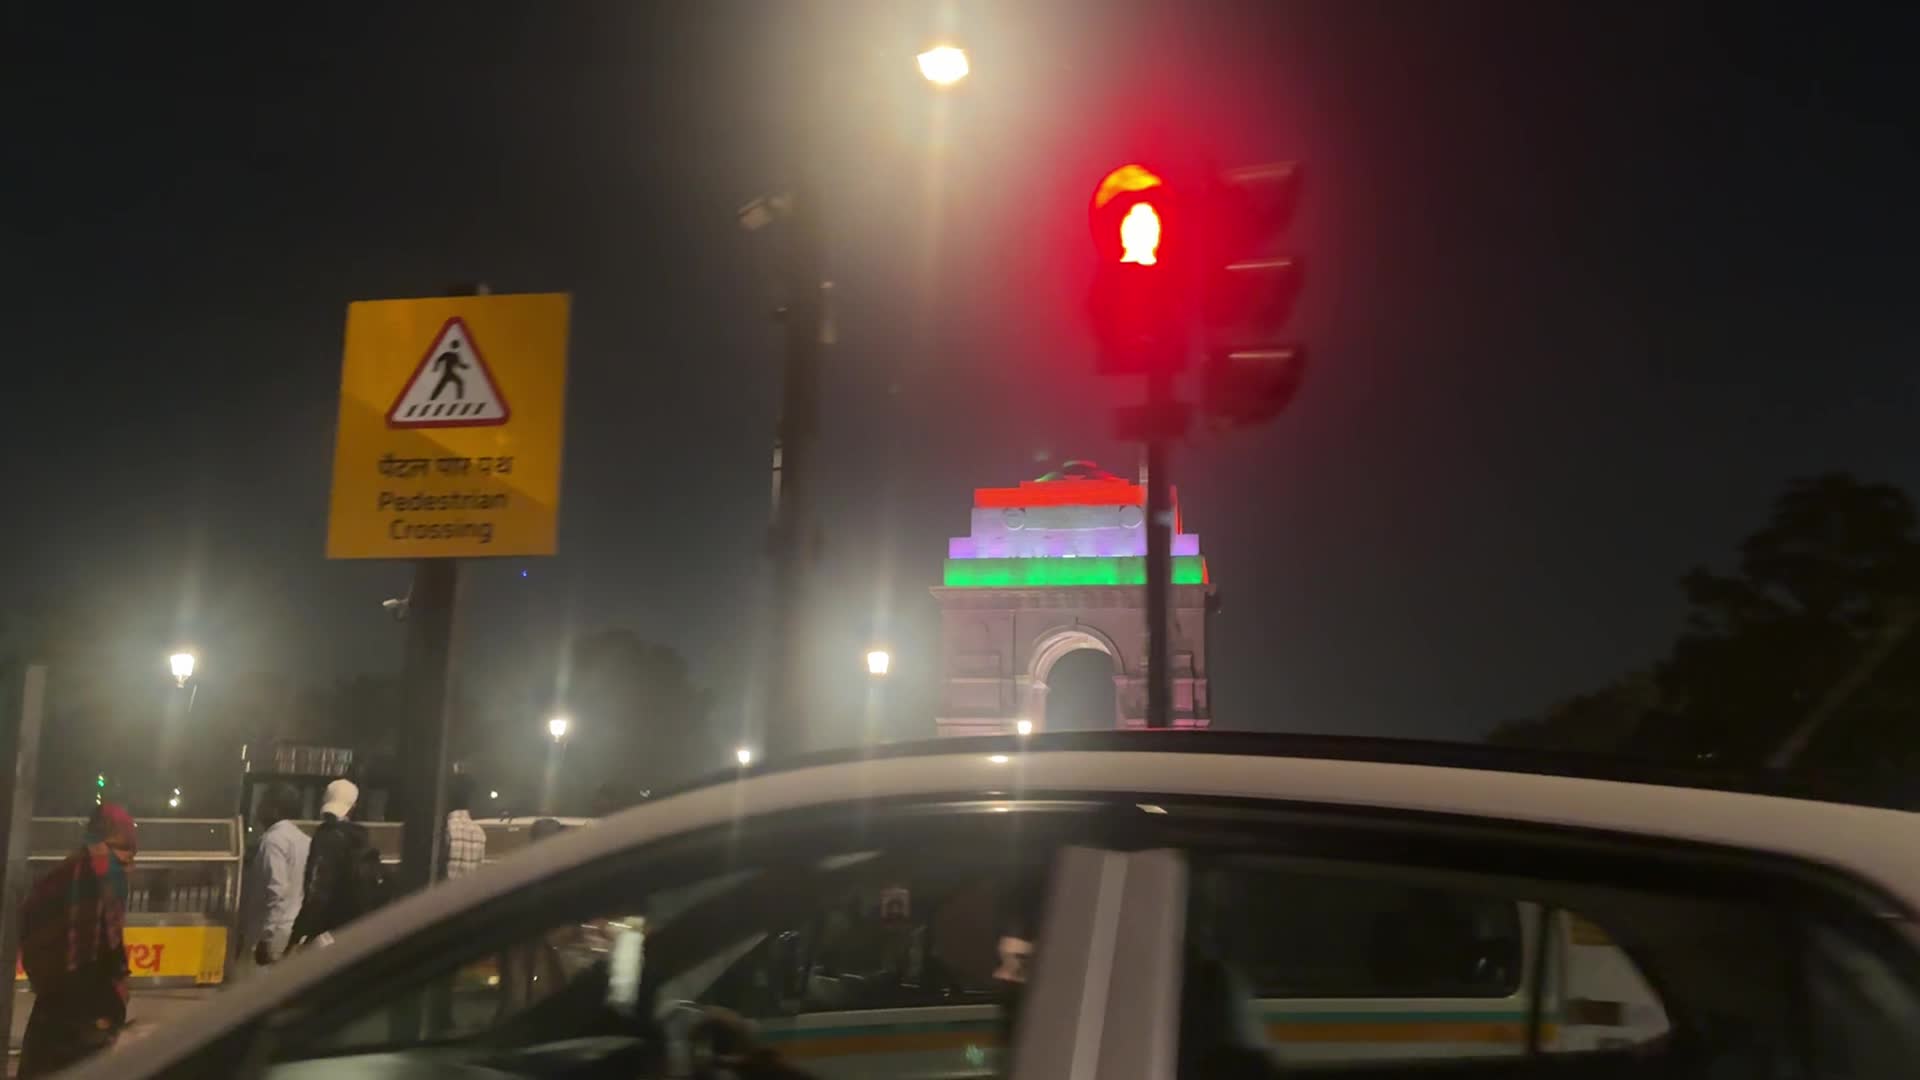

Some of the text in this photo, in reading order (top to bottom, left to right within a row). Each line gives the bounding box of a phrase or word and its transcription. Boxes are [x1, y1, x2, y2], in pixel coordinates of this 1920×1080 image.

[378, 452, 432, 477] पैदल
[378, 490, 507, 511] Pedestrian
[389, 518, 493, 544] Crossing
